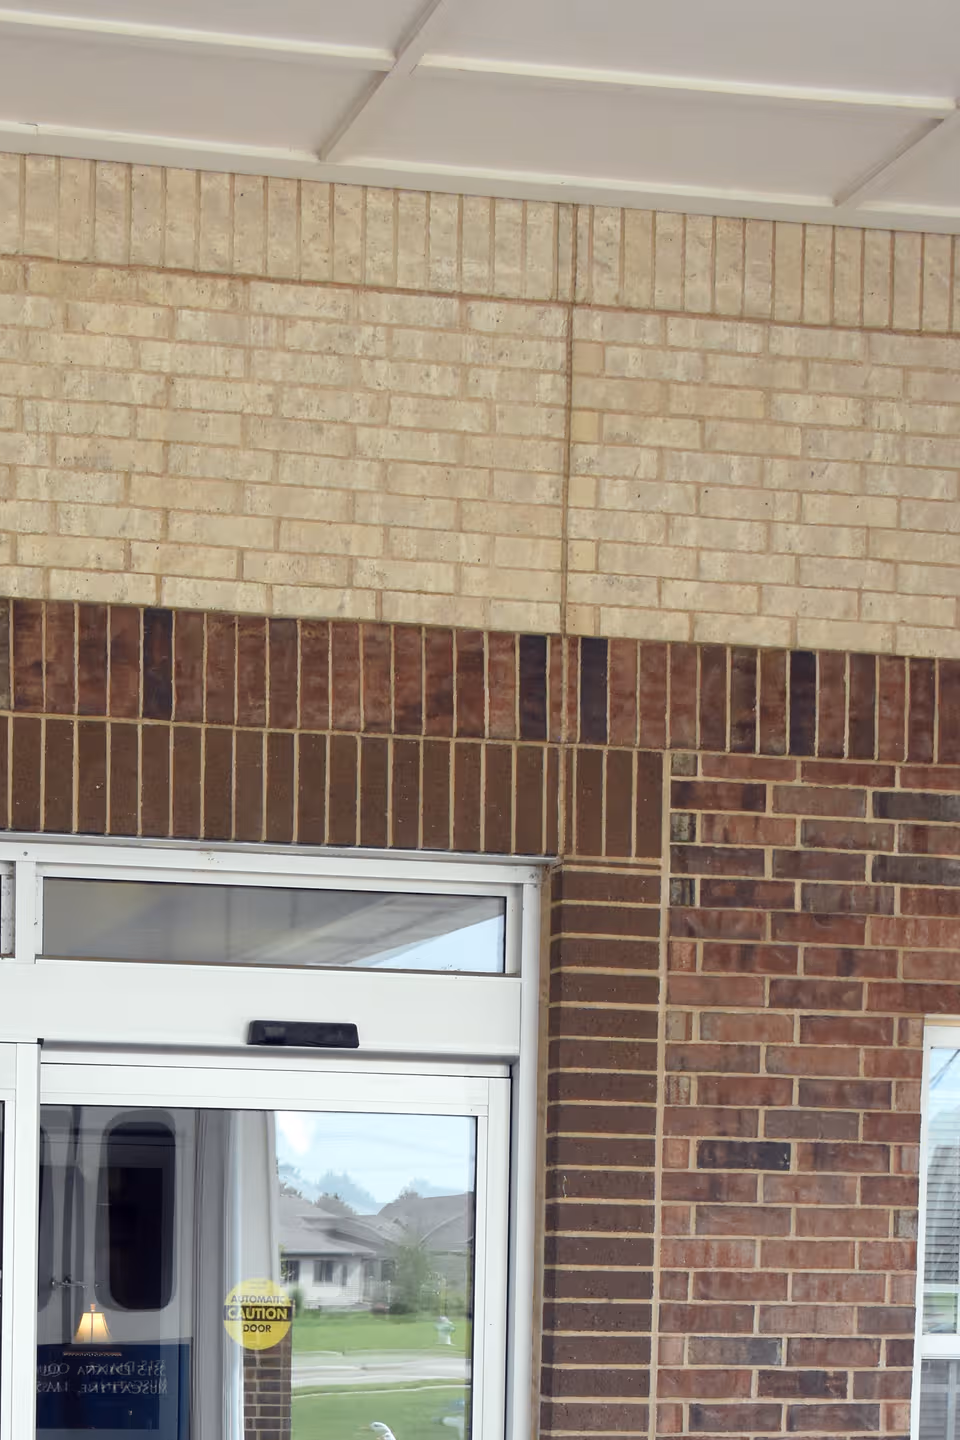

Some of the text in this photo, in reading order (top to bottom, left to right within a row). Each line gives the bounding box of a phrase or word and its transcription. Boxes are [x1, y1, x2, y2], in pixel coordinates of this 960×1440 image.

[230, 1295, 286, 1304] AUTOMATIC
[228, 1307, 289, 1320] CAUTION
[243, 1324, 272, 1333] DOOR
